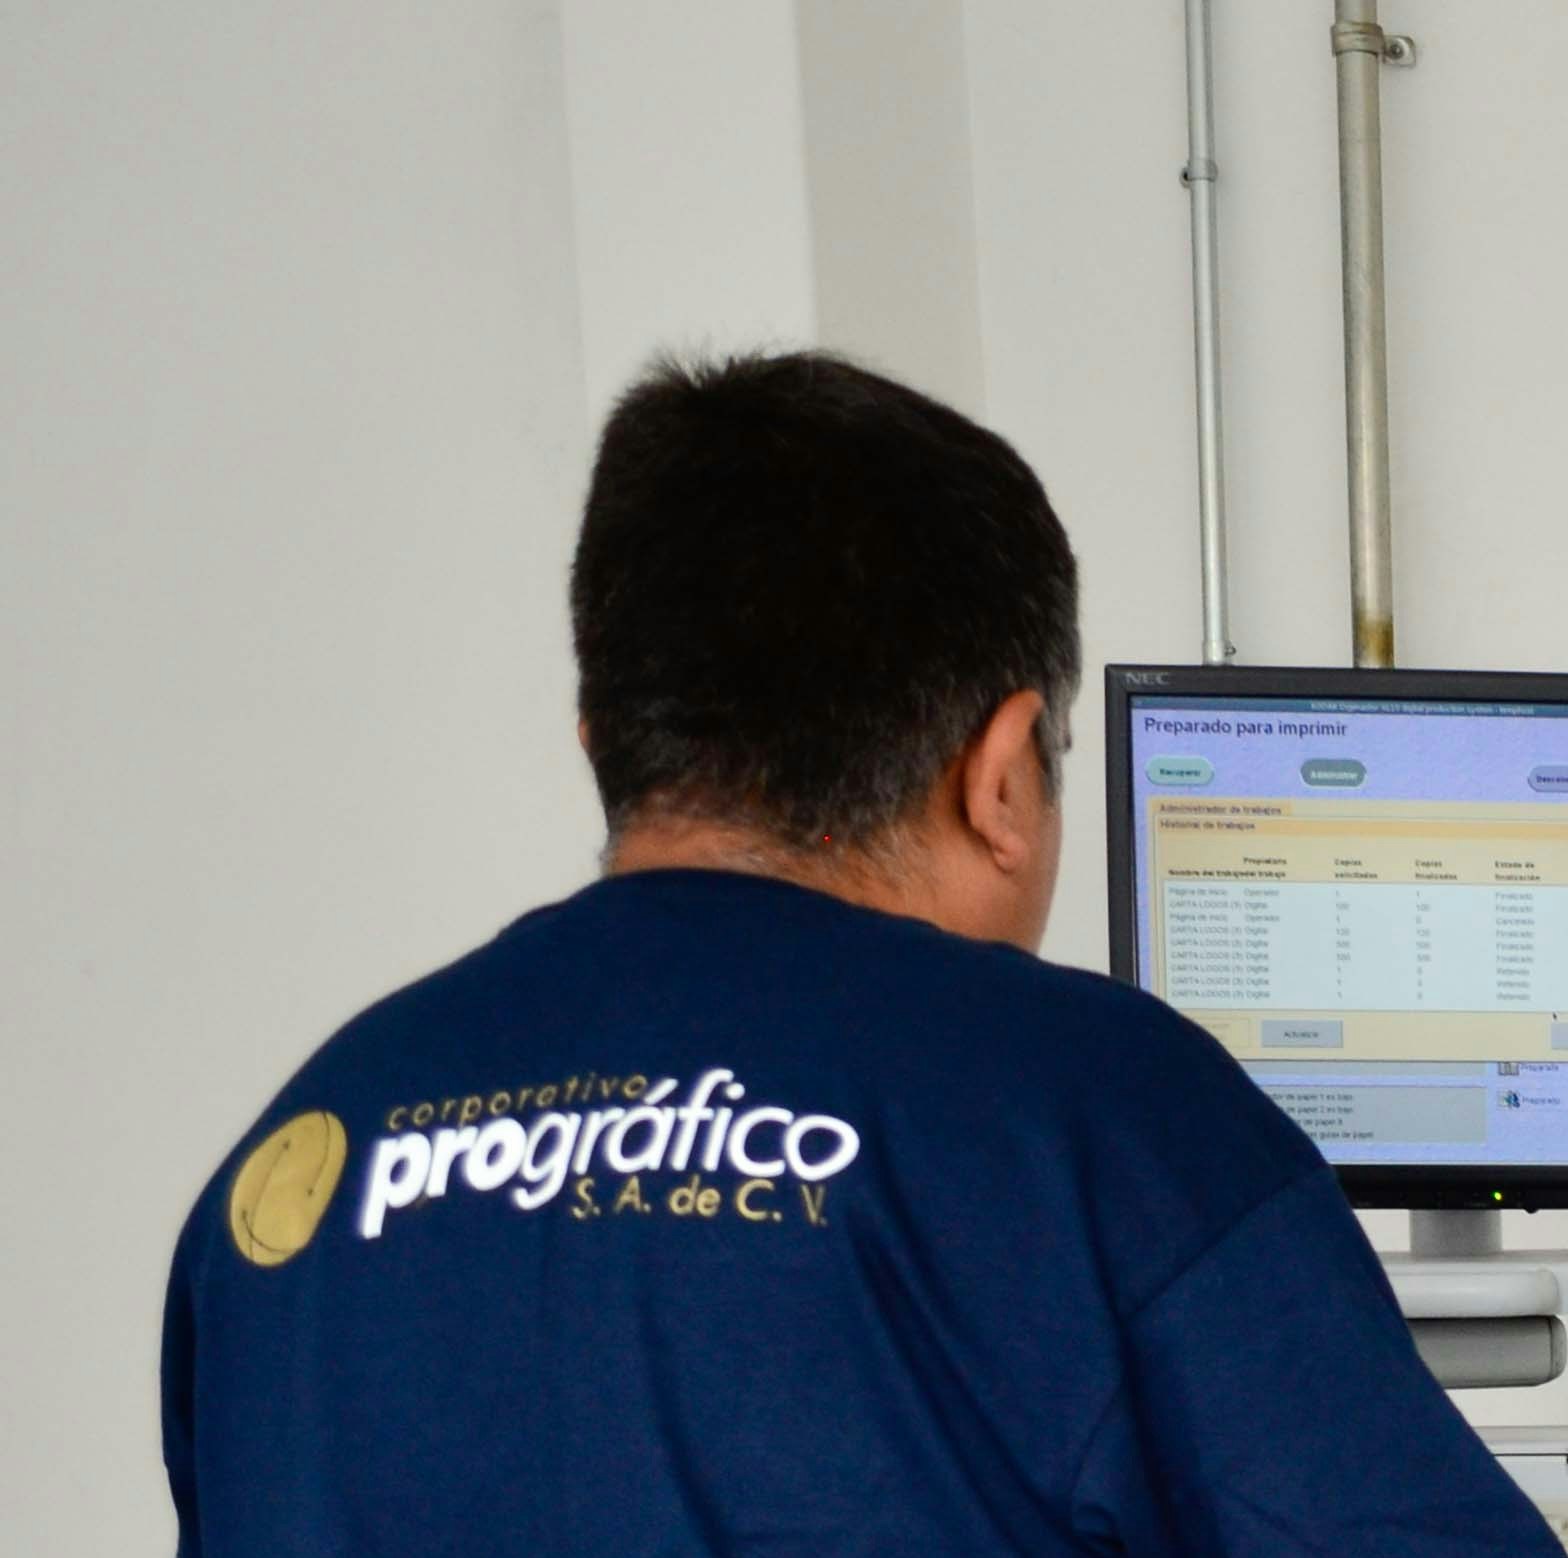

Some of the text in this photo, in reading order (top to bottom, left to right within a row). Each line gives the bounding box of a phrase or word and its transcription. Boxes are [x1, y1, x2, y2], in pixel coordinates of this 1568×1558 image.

[1125, 672, 1170, 685] NEC
[1144, 717, 1347, 739] Preparado para imprimir
[1160, 804, 1282, 816] Administrador de trabajos
[1160, 820, 1255, 831] Historial de trabajos
[387, 1072, 647, 1131] corporativo
[361, 1068, 860, 1239] prográfico
[571, 1174, 828, 1227] S. A. de C. V.
